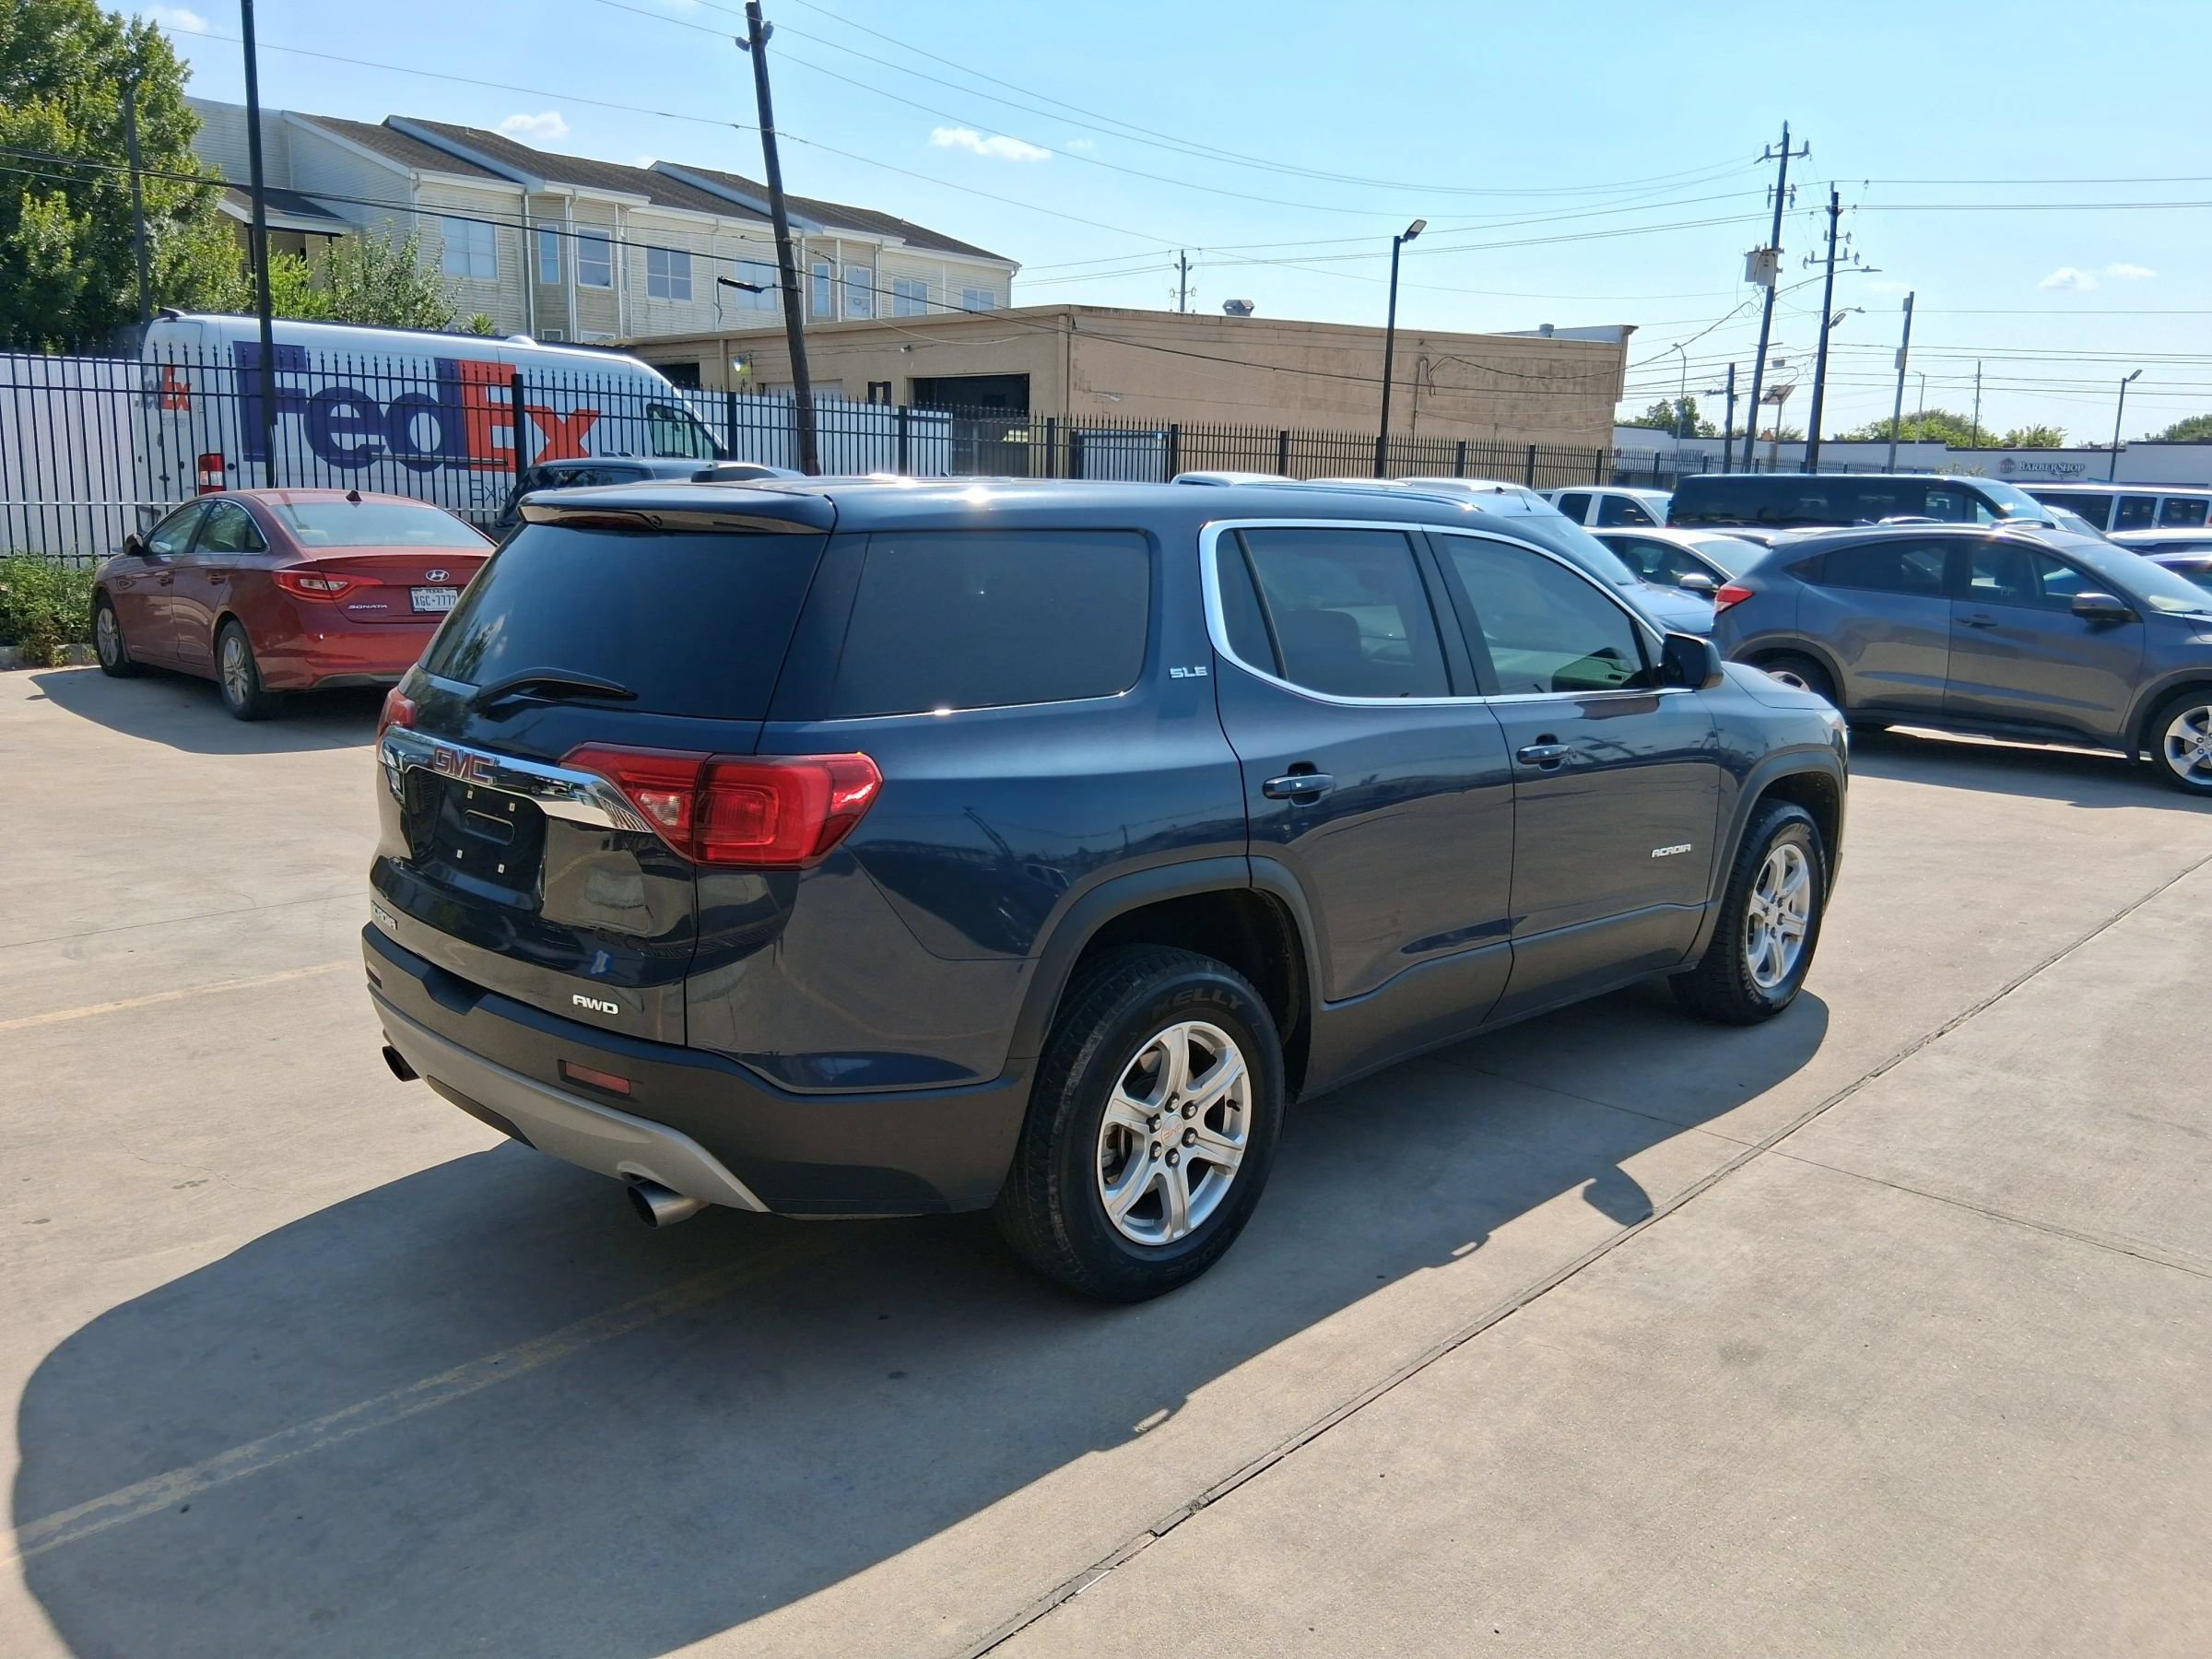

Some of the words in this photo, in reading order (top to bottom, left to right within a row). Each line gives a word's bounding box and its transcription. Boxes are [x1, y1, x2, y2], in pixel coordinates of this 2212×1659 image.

[141, 366, 192, 410] edEx
[233, 341, 602, 473] FedEx
[1170, 665, 1208, 679] SLE
[432, 745, 495, 786] GMC
[1651, 843, 1691, 858] ACADIA
[572, 994, 619, 1016] AWD
[1150, 987, 1246, 1018] KELLY
